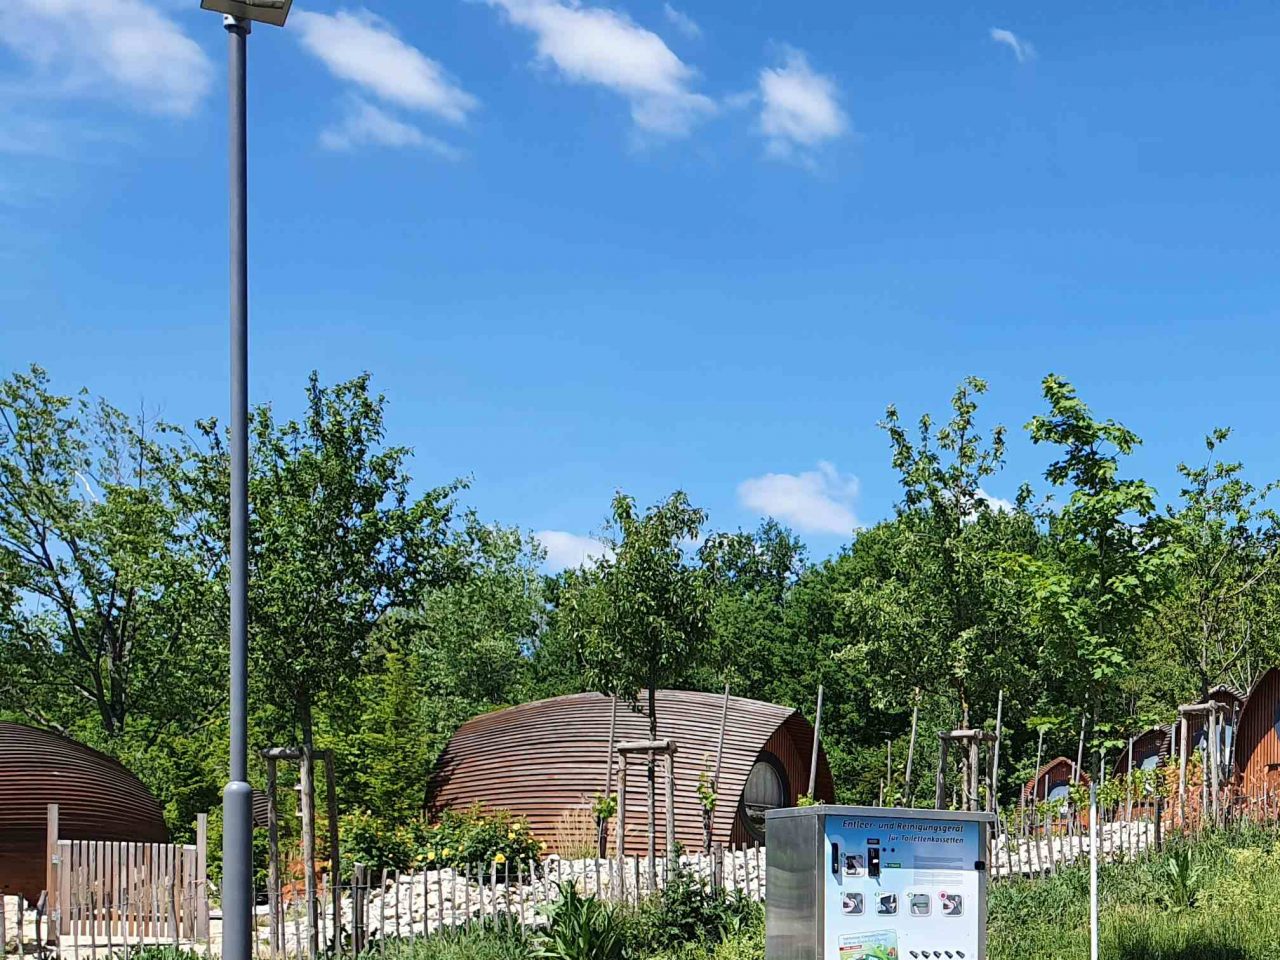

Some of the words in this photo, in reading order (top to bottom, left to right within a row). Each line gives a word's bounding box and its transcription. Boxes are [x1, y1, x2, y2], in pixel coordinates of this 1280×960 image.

[842, 820, 875, 829] Entleer-
[879, 821, 894, 830] und
[901, 834, 964, 844] Toilettenkassetten
